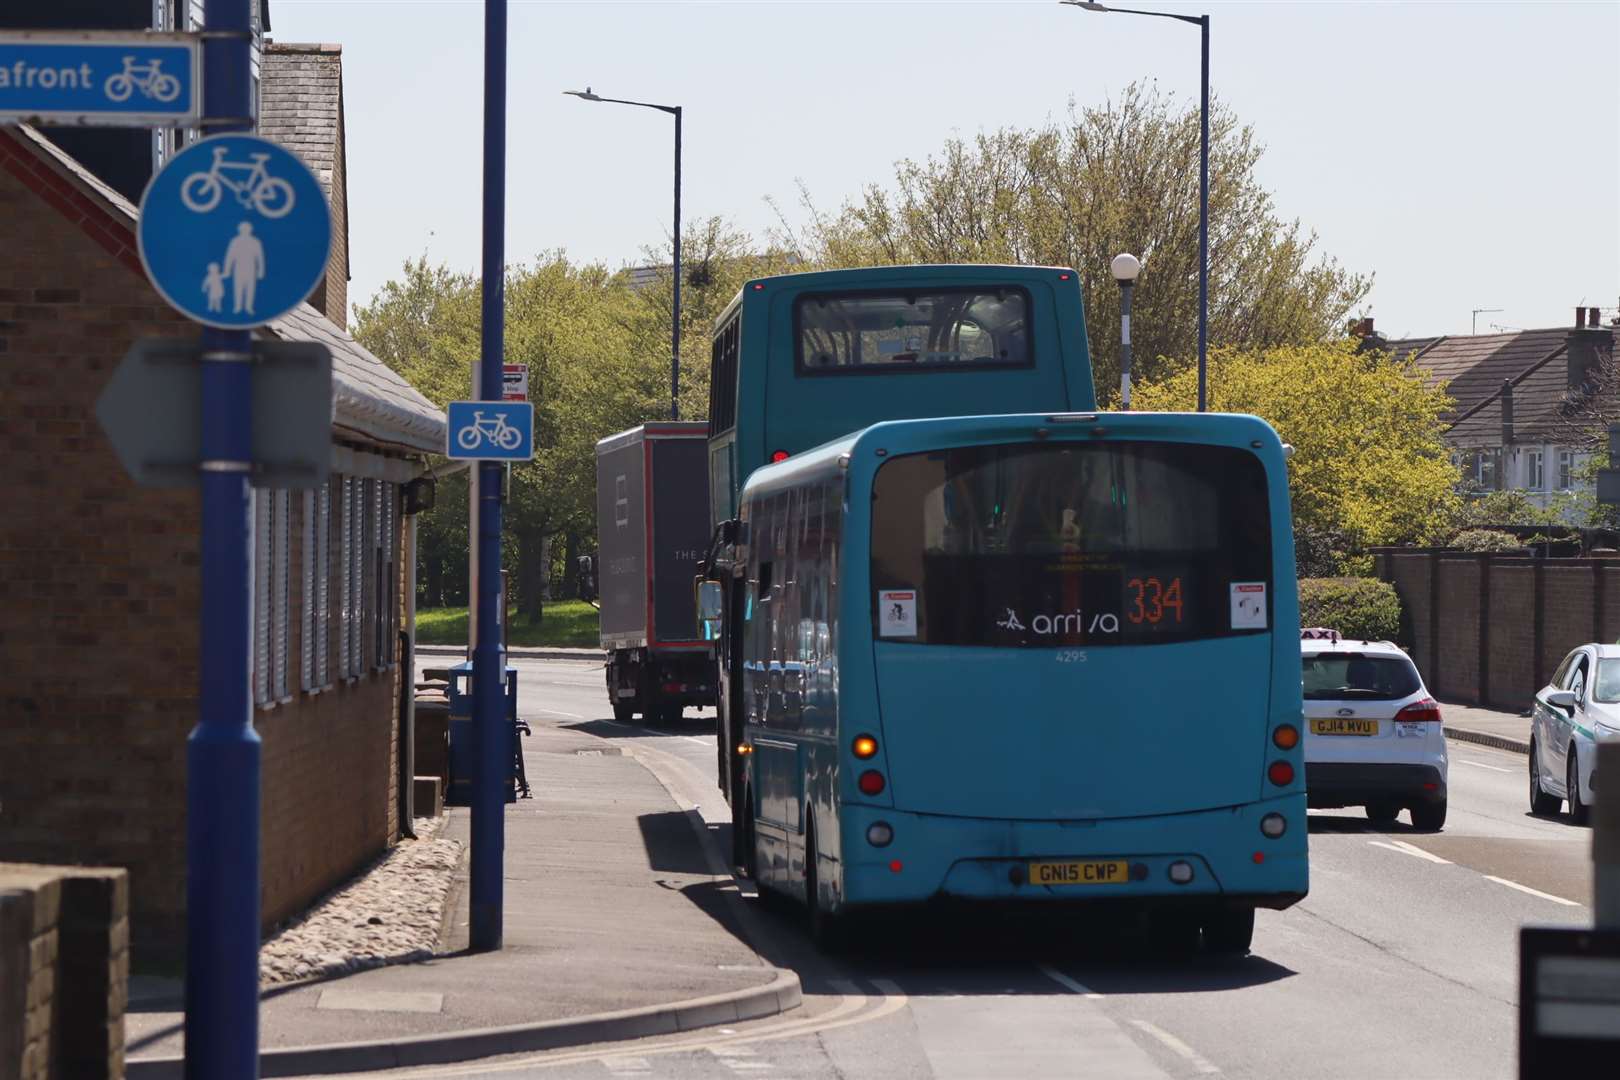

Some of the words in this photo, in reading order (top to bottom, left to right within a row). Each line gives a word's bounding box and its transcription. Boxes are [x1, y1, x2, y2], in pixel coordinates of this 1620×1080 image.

[675, 550, 697, 560] THE
[1127, 576, 1184, 624] 334
[1301, 630, 1336, 639] AXI
[1056, 652, 1087, 663] 4295
[1317, 720, 1343, 732] GJ14
[1347, 720, 1371, 732] MVU
[1040, 864, 1079, 881] GN15
[1083, 863, 1117, 880] CWP
